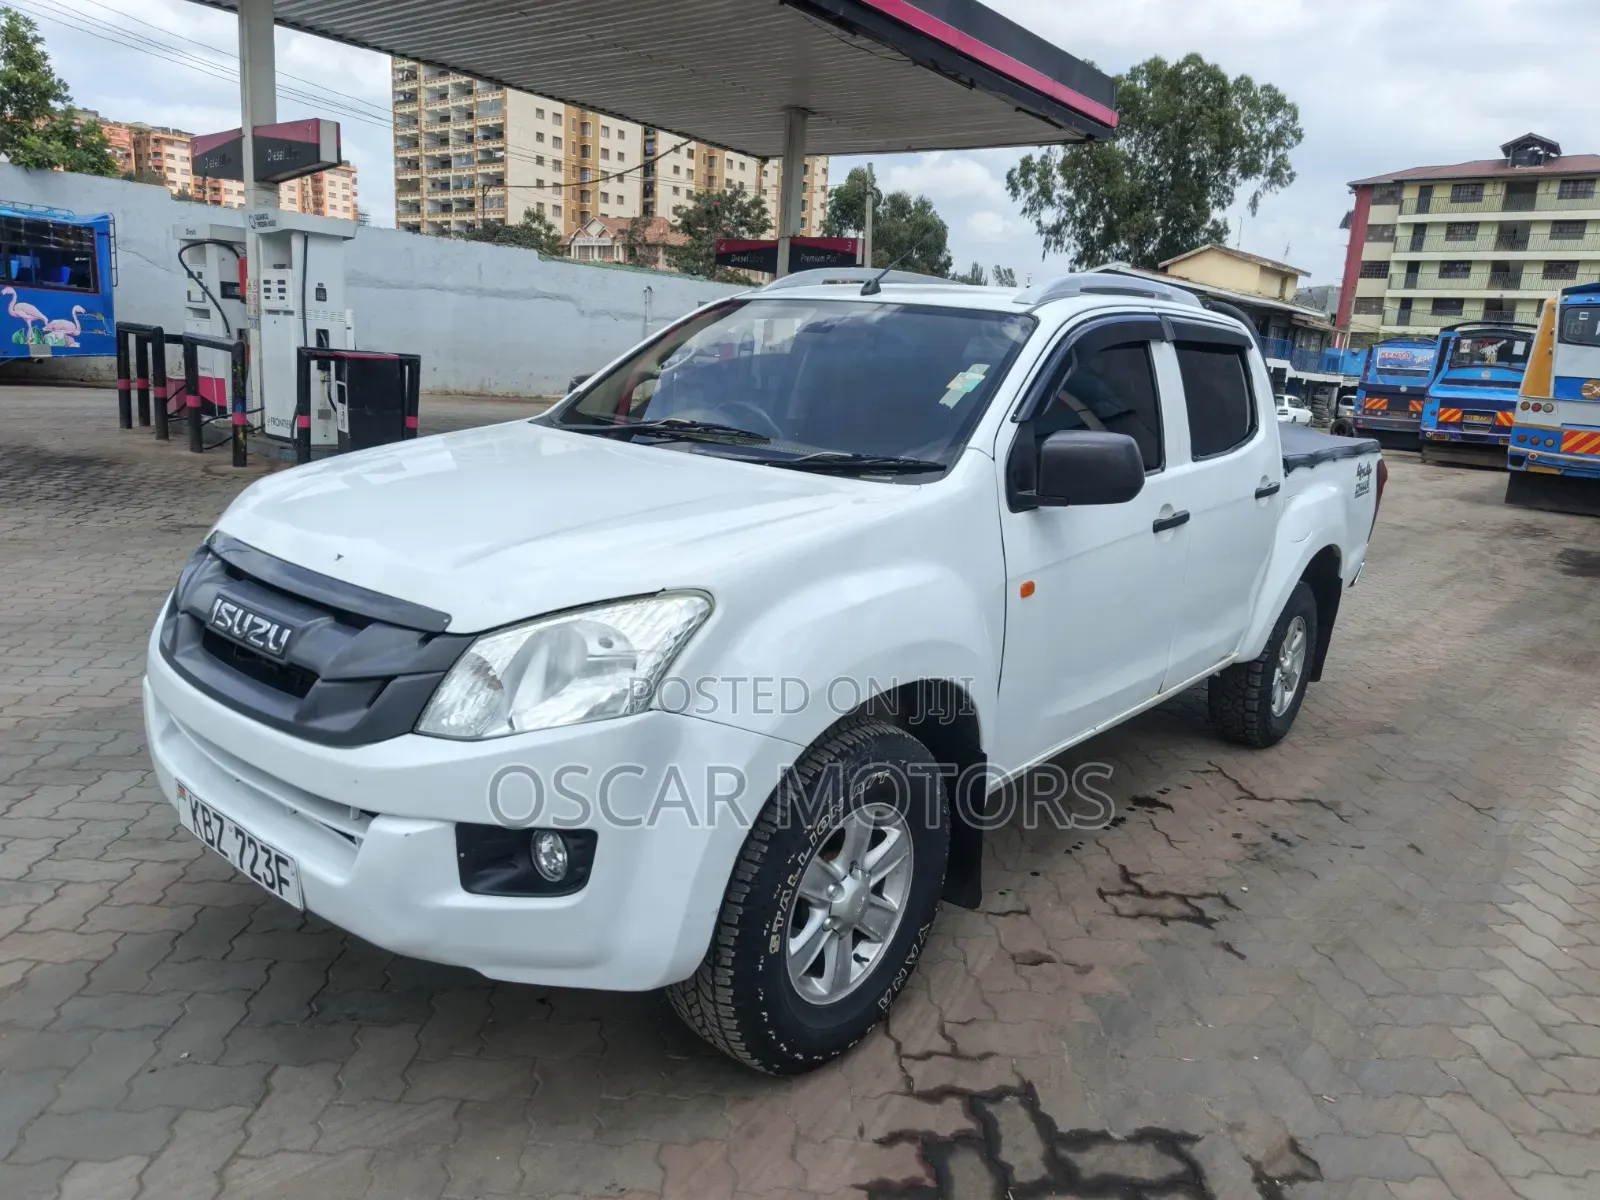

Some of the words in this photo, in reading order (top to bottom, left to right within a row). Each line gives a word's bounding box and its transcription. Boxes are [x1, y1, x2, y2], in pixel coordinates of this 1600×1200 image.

[731, 253, 749, 263] Diesel
[800, 253, 825, 263] Premium
[1380, 351, 1410, 360] KENYA
[211, 597, 292, 652] ISUZU
[189, 794, 229, 858] KBZ
[234, 826, 291, 897] 723F
[769, 797, 845, 955] STALLION
[877, 923, 931, 1011] YANA
